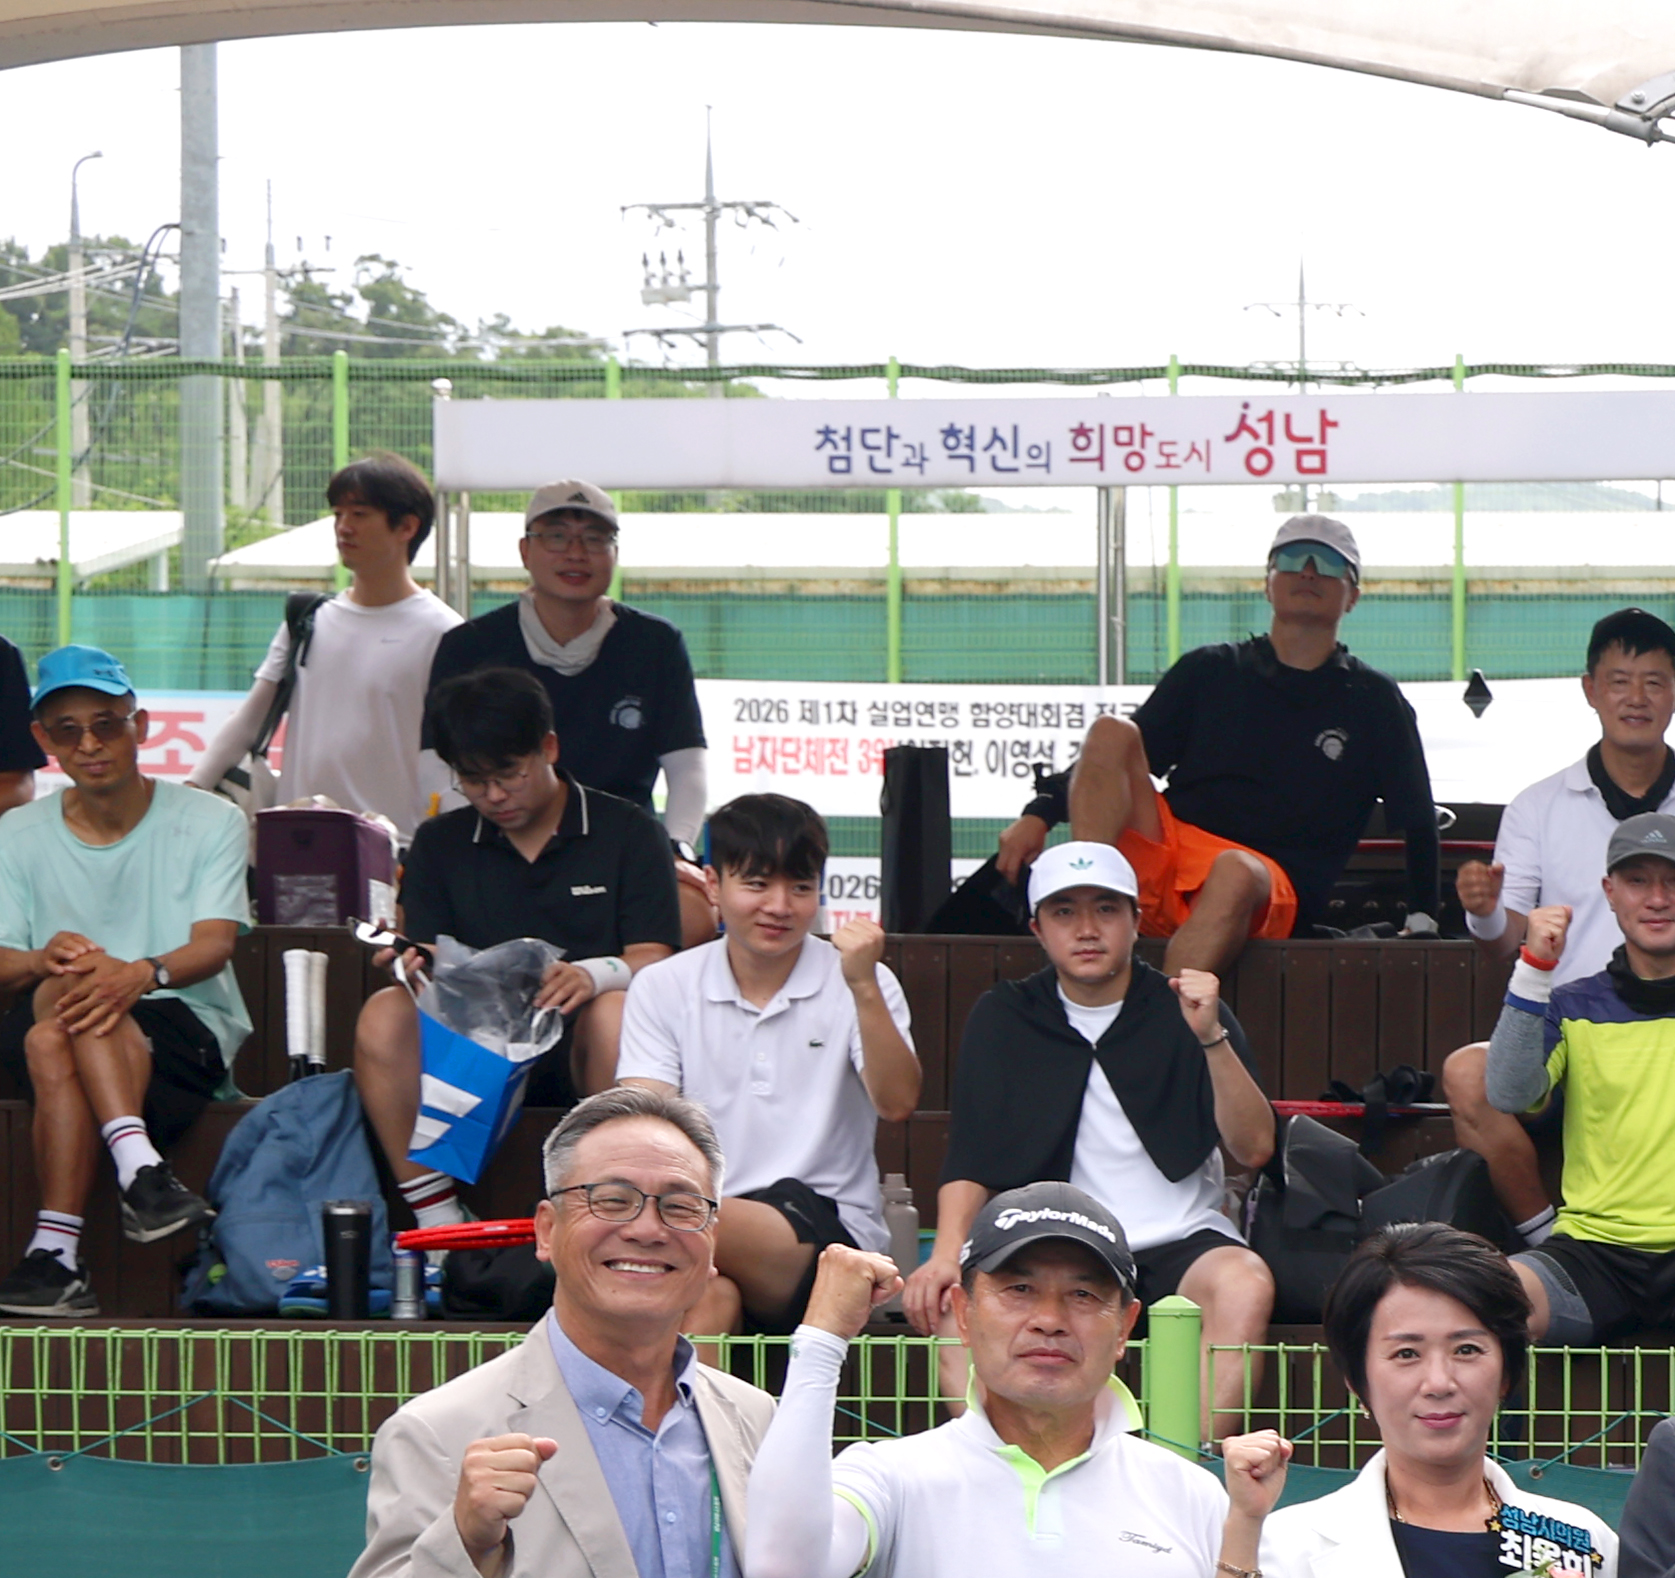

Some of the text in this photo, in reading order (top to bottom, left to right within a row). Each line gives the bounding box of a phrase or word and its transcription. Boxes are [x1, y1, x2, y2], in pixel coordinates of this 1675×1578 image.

[815, 402, 1338, 477] 첨단과 혁신의 희망도시 성남
[734, 699, 789, 723] 2026
[799, 700, 857, 727] 제1차
[867, 701, 959, 728] 실업연맹
[971, 702, 1085, 729] 함양대회겸
[733, 736, 849, 775] 남자단체전
[822, 874, 881, 900] 026
[994, 1207, 1117, 1244] TaylorMade
[1500, 1504, 1592, 1553] 성남시의원
